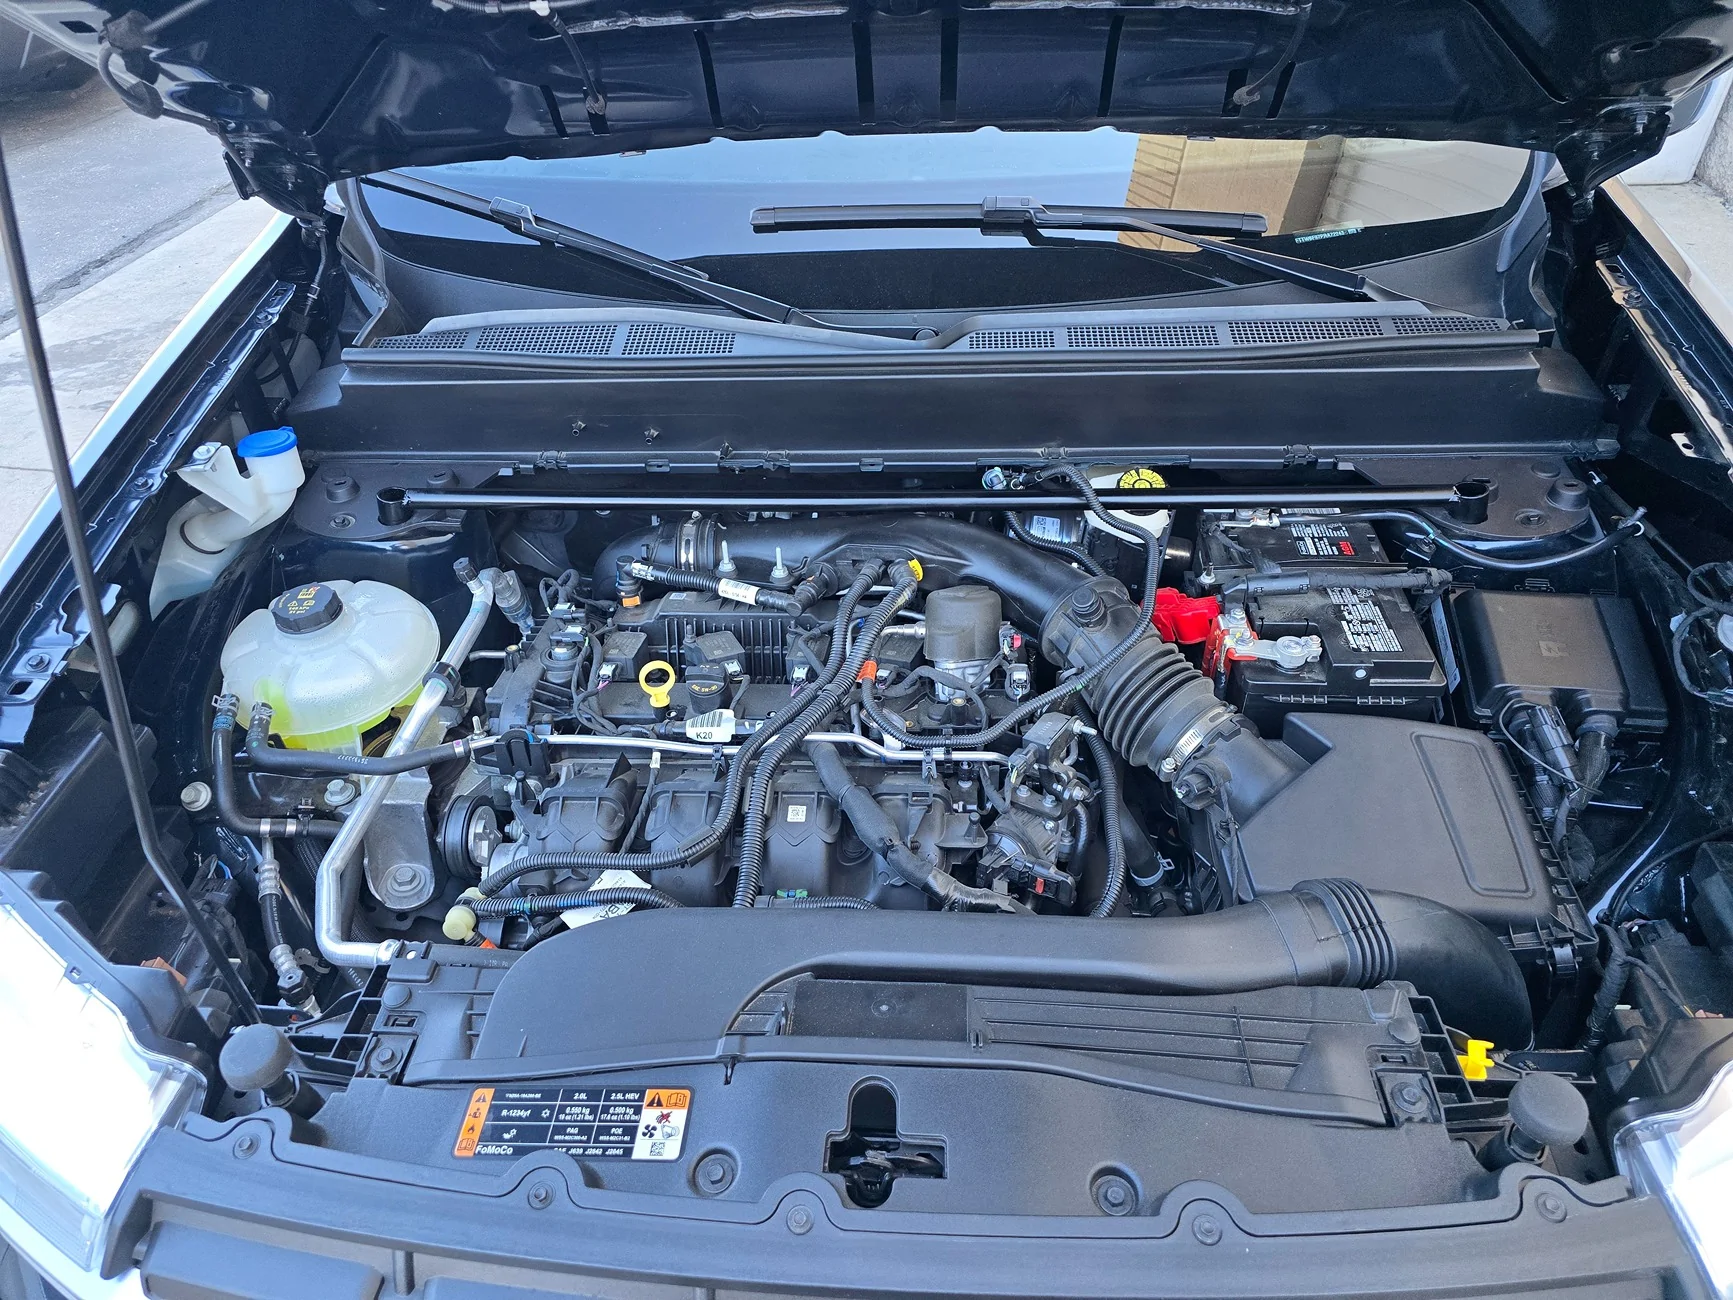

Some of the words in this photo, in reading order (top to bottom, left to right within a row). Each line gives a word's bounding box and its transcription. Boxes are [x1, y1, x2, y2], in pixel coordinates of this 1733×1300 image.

[695, 731, 713, 740] K20
[573, 1092, 588, 1100] 2.0L
[610, 1092, 624, 1100] 2.5L
[624, 1092, 640, 1100] HEV
[501, 1109, 532, 1118] R-1234yf
[582, 1106, 591, 1115] kg
[626, 1106, 634, 1115] kg
[475, 1145, 514, 1155] FoMoCo
